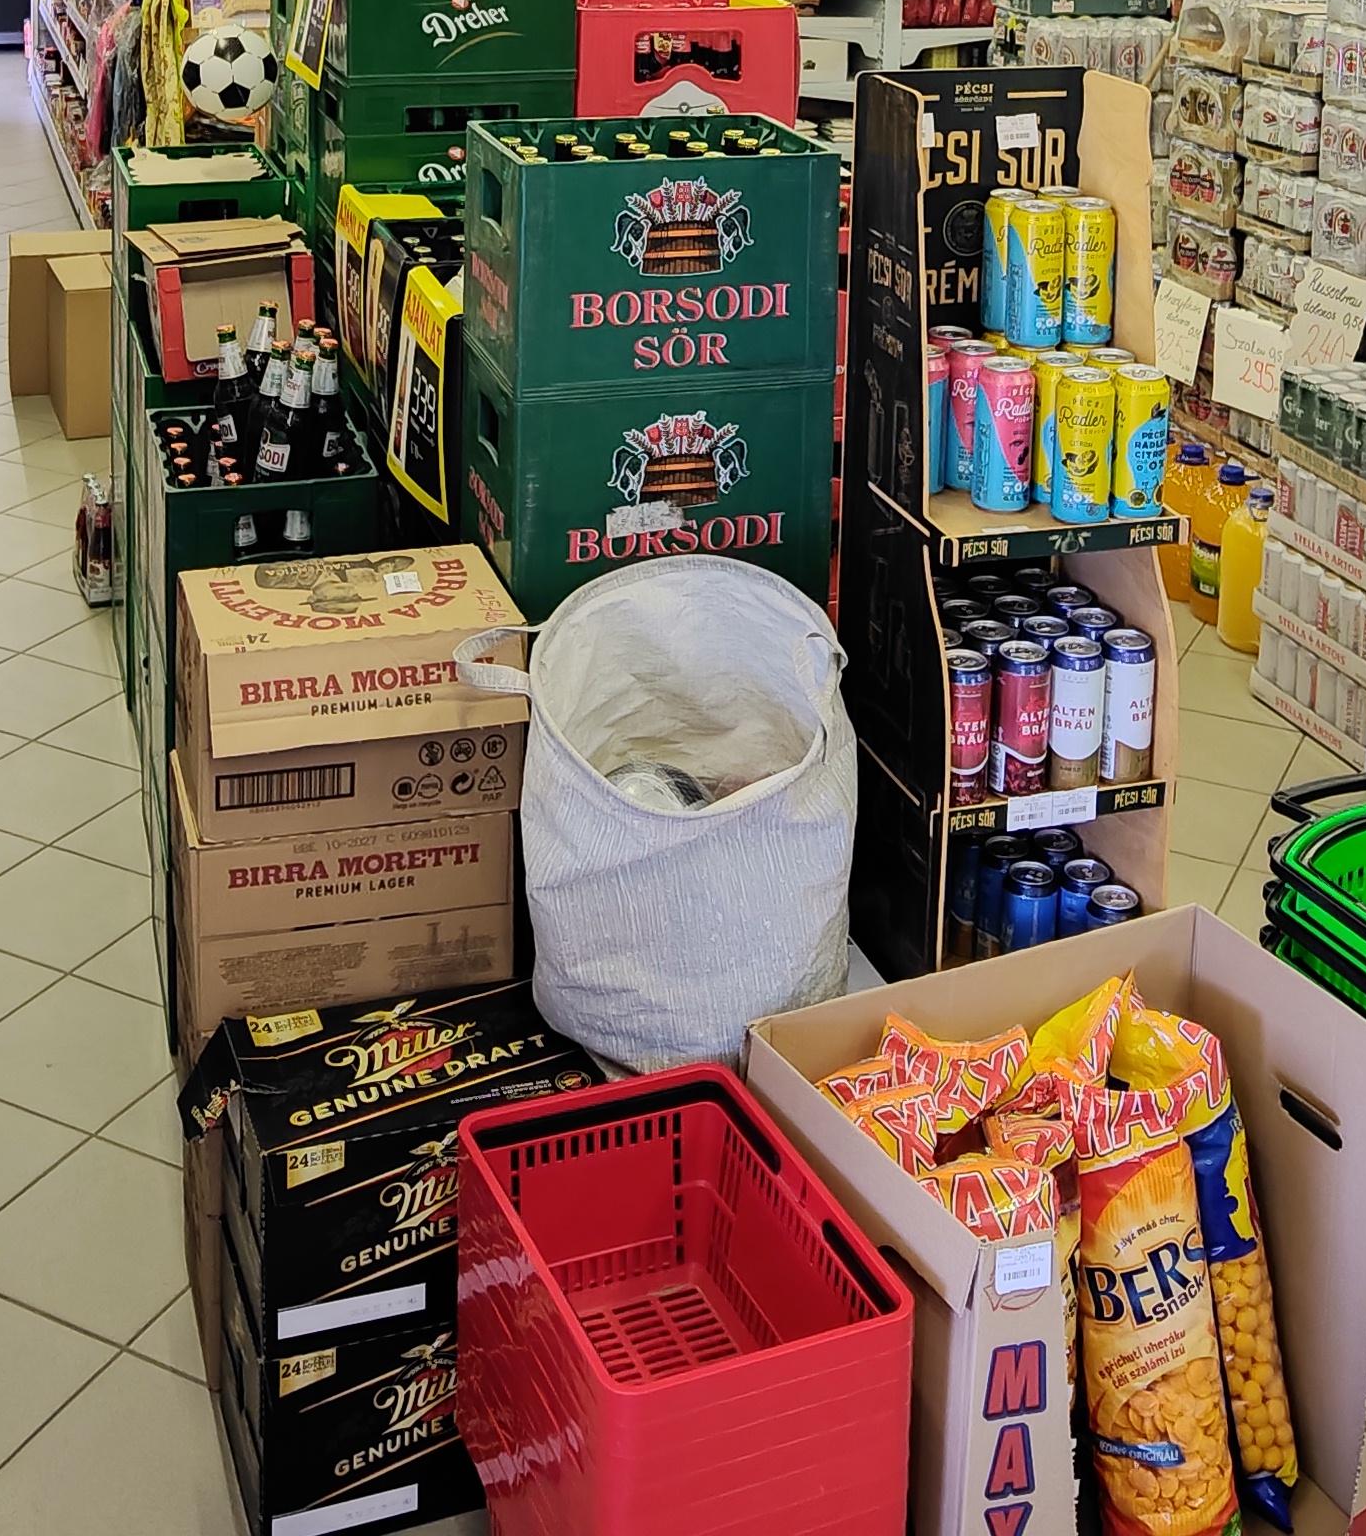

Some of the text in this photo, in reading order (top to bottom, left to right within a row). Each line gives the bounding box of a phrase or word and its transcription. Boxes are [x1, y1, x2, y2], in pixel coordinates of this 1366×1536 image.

[420, 3, 511, 49] Dreher
[953, 80, 995, 96] PÉCSI
[569, 282, 792, 330] BORSODI
[406, 289, 443, 358] AJÁNLAT
[633, 326, 731, 371] SÖR
[1058, 405, 1108, 429] Radler
[564, 511, 787, 565] BORSODI
[1129, 522, 1175, 545] PÉCSI SÖR
[961, 536, 1009, 559] PÉCSI SÖR
[1293, 531, 1324, 555] STELLA
[1330, 555, 1364, 581] ARTOIS
[1277, 614, 1347, 666] STELLA ARTOIS
[239, 673, 344, 706] BIRRA
[310, 691, 433, 717] PREMIUM LAGER
[1051, 703, 1096, 716] ALTEN
[1274, 695, 1304, 721] STELLA
[949, 719, 988, 733] LTEN
[1054, 717, 1094, 731] BRÄU
[1113, 790, 1139, 811] PÉCSI
[1140, 786, 1158, 805] SÖR
[949, 810, 996, 833] PÉCSI SÖR
[227, 843, 481, 890] BIRRA MORETTI
[295, 874, 416, 899] PREMIUM LAGER
[247, 1017, 273, 1036] 24
[324, 1020, 479, 1089] Miller
[288, 1068, 435, 1128] GENUINE
[444, 1032, 547, 1078] DRAFT
[287, 1150, 311, 1170] 24
[339, 1215, 452, 1274] GENUINE
[1151, 1270, 1207, 1324] snack
[280, 1359, 303, 1378] 24
[333, 1416, 444, 1477] GENUINE
